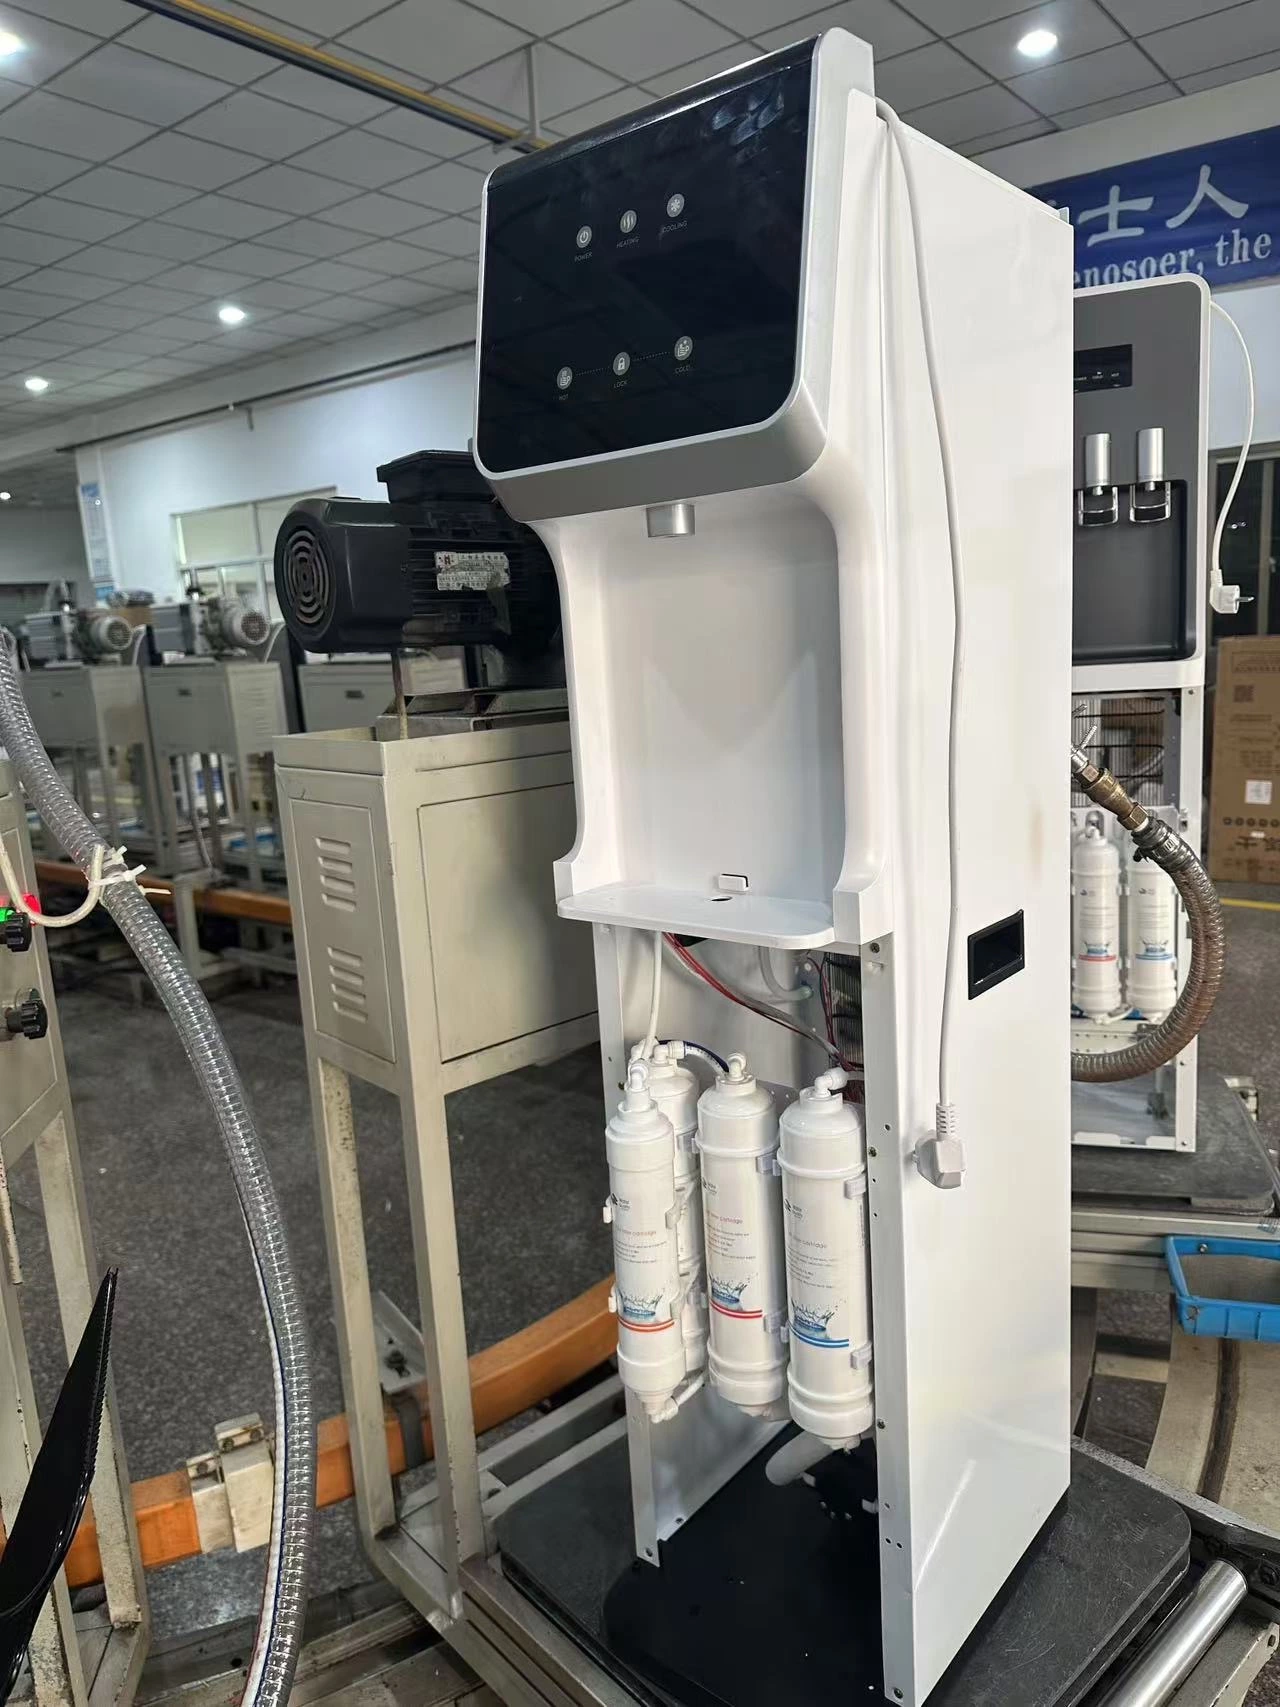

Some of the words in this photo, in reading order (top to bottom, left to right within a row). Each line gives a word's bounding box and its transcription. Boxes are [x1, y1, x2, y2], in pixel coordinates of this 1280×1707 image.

[1077, 164, 1249, 247] 士人
[662, 220, 688, 233] COOLING
[616, 236, 640, 248] HEATING
[1215, 228, 1272, 267] the
[574, 252, 593, 262] POWER
[613, 380, 628, 389] LOCK
